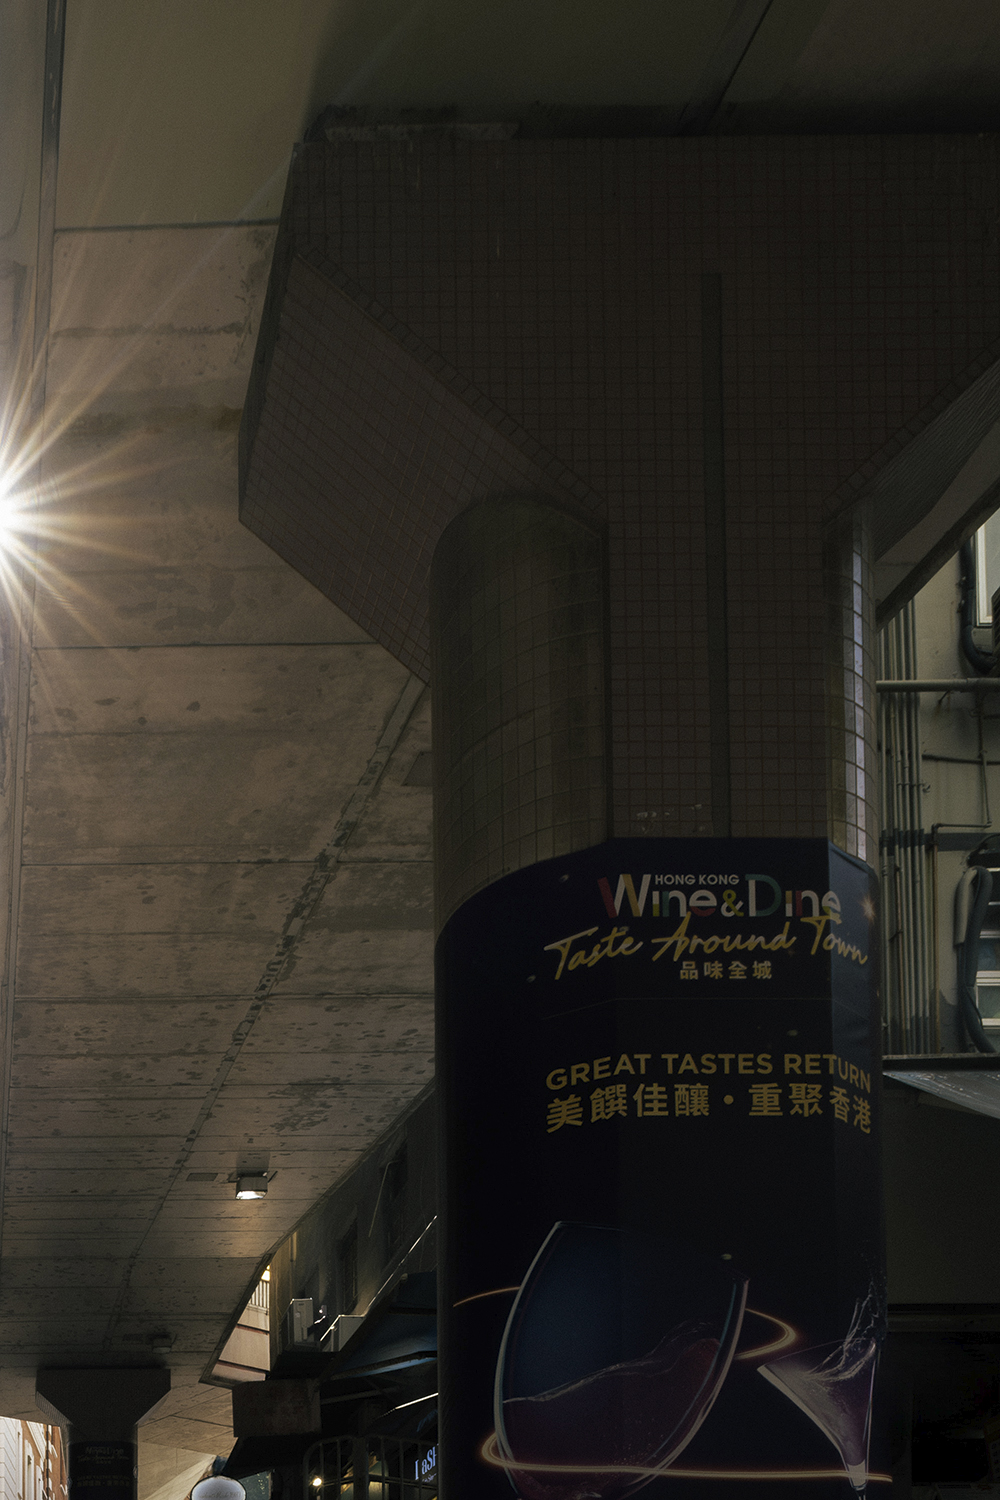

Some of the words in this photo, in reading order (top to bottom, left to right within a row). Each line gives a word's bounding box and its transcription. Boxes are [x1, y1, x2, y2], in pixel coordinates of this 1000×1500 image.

[654, 874, 697, 886] HONG
[698, 874, 740, 886] KONG
[543, 926, 644, 981] Taste
[651, 911, 797, 962] Around
[800, 914, 868, 965] Town
[679, 960, 773, 980] 品味全城
[545, 1053, 652, 1092] GREAT
[661, 1053, 774, 1075] TASTES
[783, 1053, 872, 1095] RETURN
